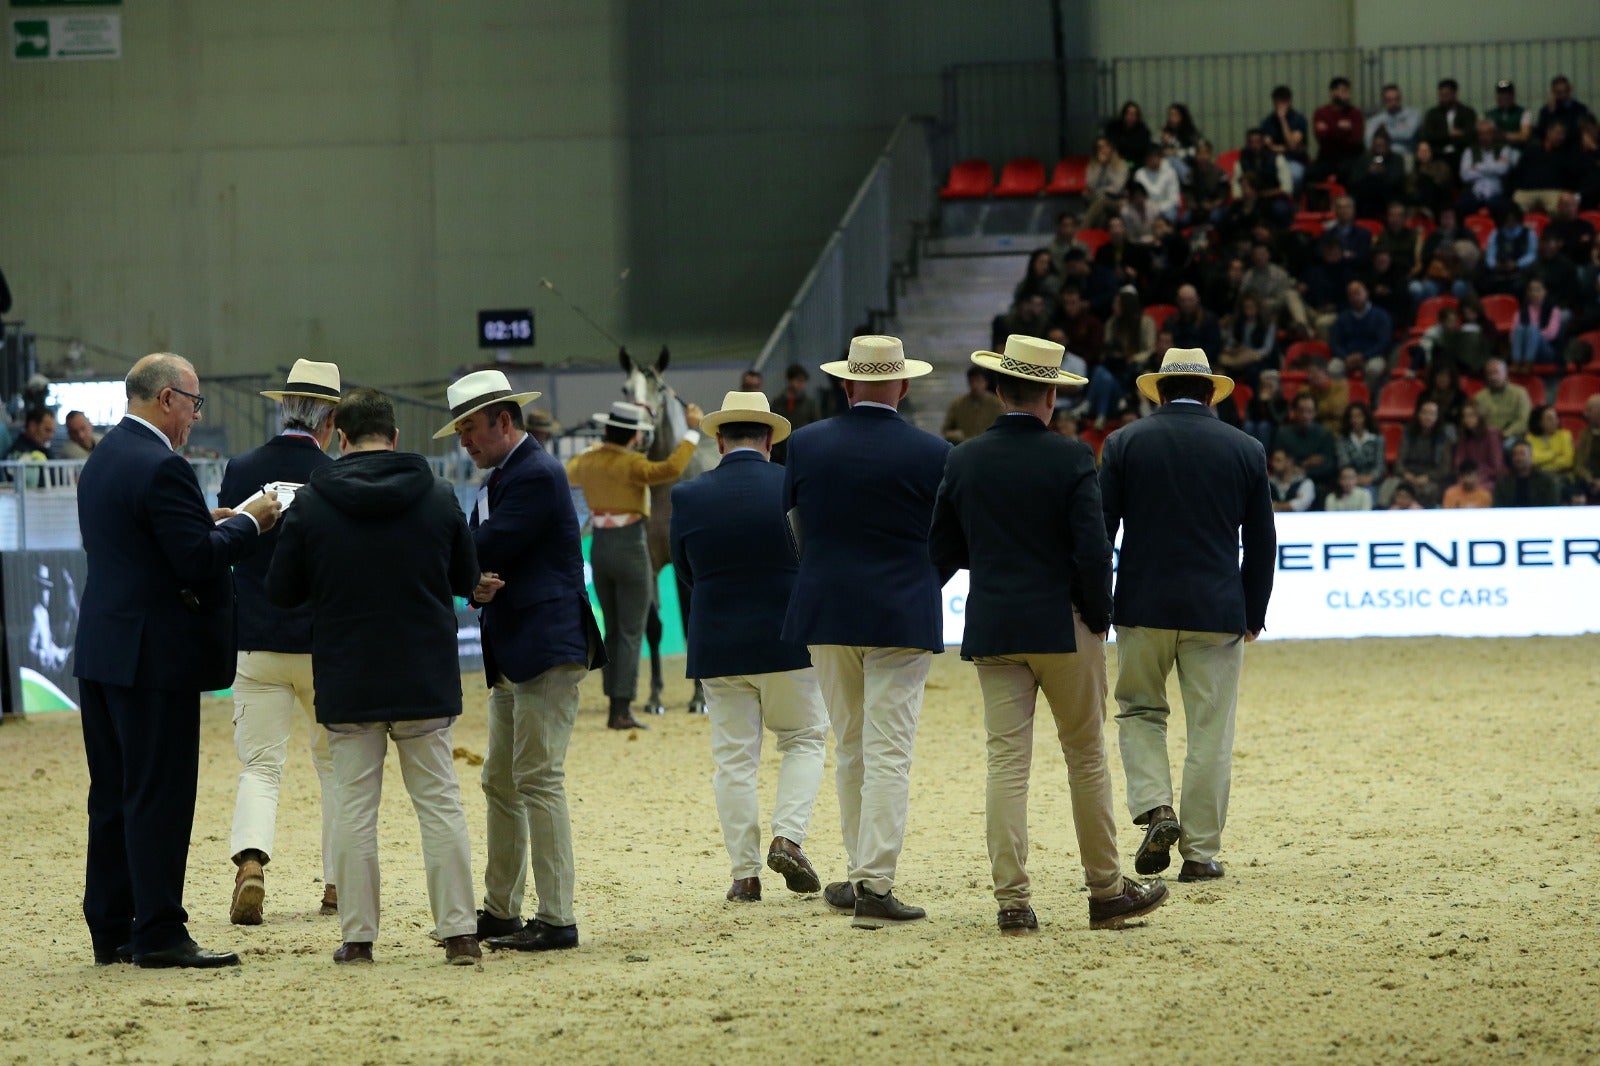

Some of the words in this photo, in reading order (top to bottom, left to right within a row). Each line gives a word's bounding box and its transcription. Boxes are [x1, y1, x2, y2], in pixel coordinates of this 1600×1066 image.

[1238, 539, 1600, 570] EFENDER
[1326, 589, 1431, 609] CLASSIC
[1440, 587, 1508, 607] CARS
